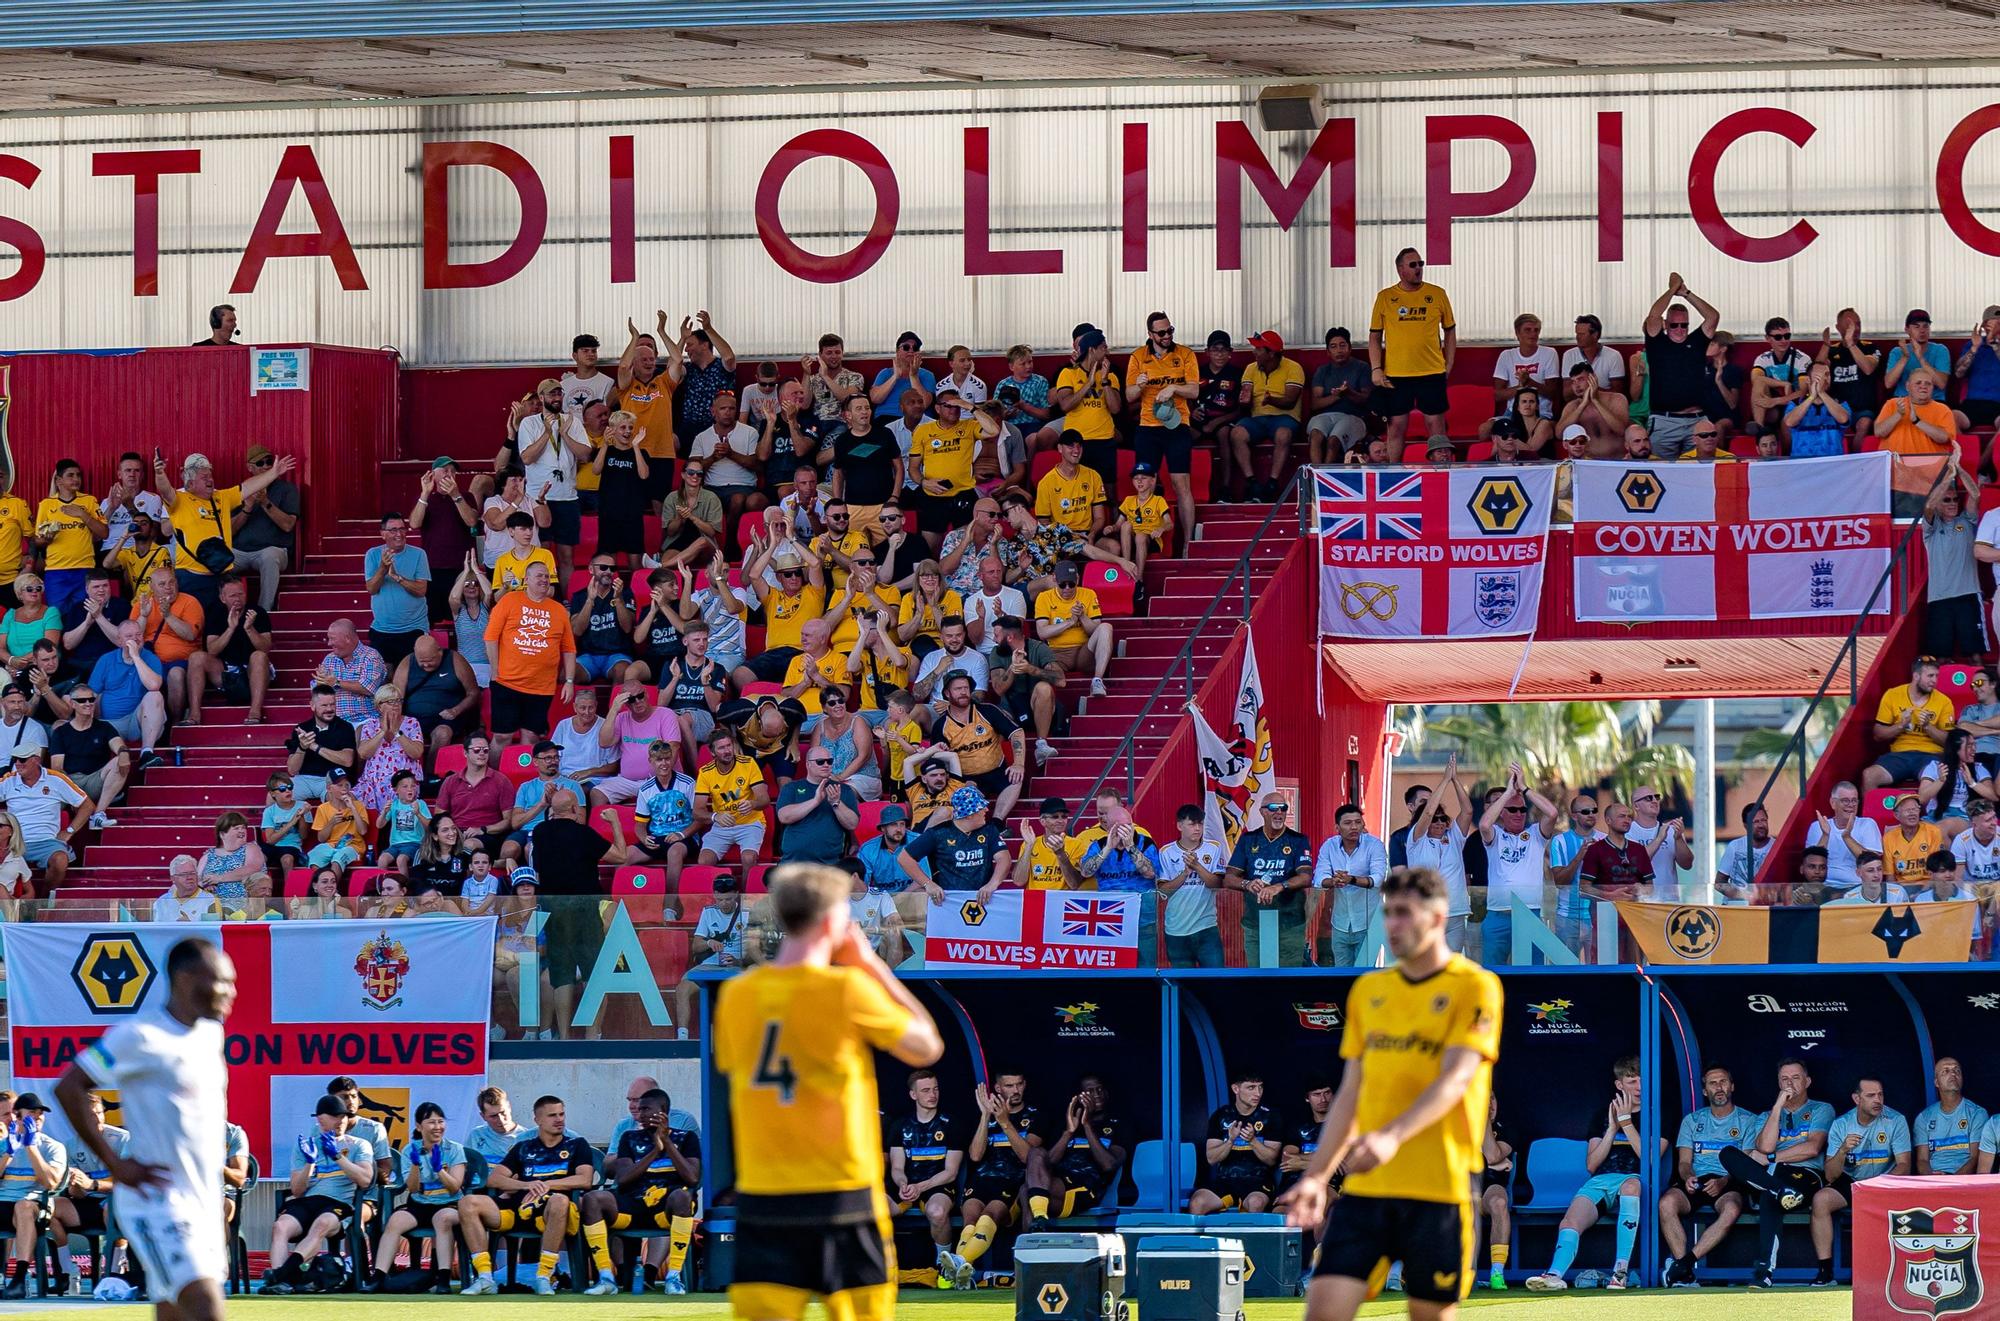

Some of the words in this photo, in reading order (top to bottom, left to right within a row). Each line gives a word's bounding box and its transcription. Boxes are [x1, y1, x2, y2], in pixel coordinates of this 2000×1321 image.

[755, 107, 1819, 285] OLIMPIC
[1595, 525, 1719, 552] COVEN
[1729, 518, 1870, 551] WOLVES
[1330, 545, 1444, 562] STAFFORD
[1450, 542, 1538, 562] WOLVES
[520, 615, 551, 628] SHARK
[946, 942, 1036, 963] WOLVES
[1041, 947, 1069, 964] AY
[1074, 949, 1116, 966] WE!
[297, 1032, 476, 1066] WOLVES
[753, 1020, 798, 1104] 4
[1912, 1239, 1923, 1248] C.
[1945, 1238, 1954, 1248] F.
[1909, 1264, 1962, 1284] NUCÍA
